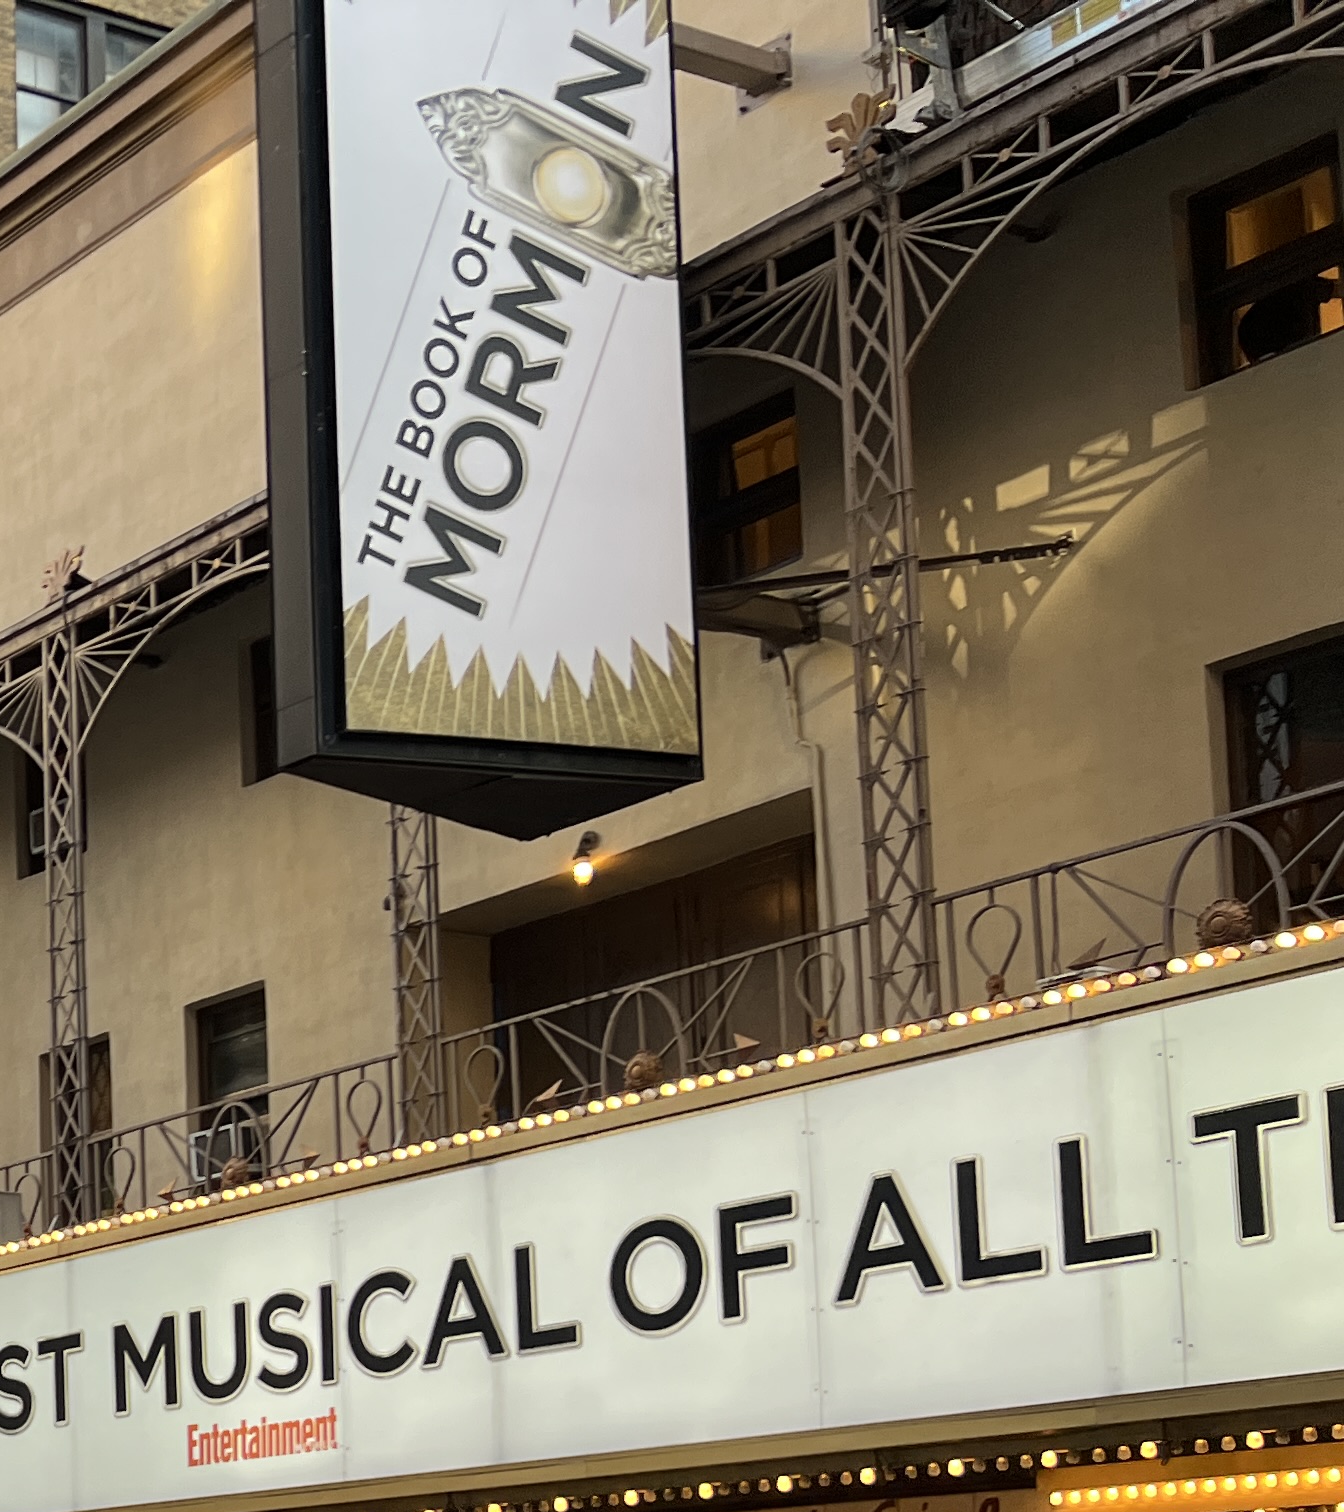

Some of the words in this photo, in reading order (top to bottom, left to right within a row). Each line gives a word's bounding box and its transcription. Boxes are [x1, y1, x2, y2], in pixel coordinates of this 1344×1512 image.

[357, 464, 423, 569] THE
[396, 296, 477, 455] BOOK
[451, 209, 500, 289] OF
[112, 1243, 582, 1416] MUSICAL
[609, 1192, 796, 1334] OF
[835, 1136, 1156, 1306] ALL
[187, 1407, 337, 1467] Entertainment
